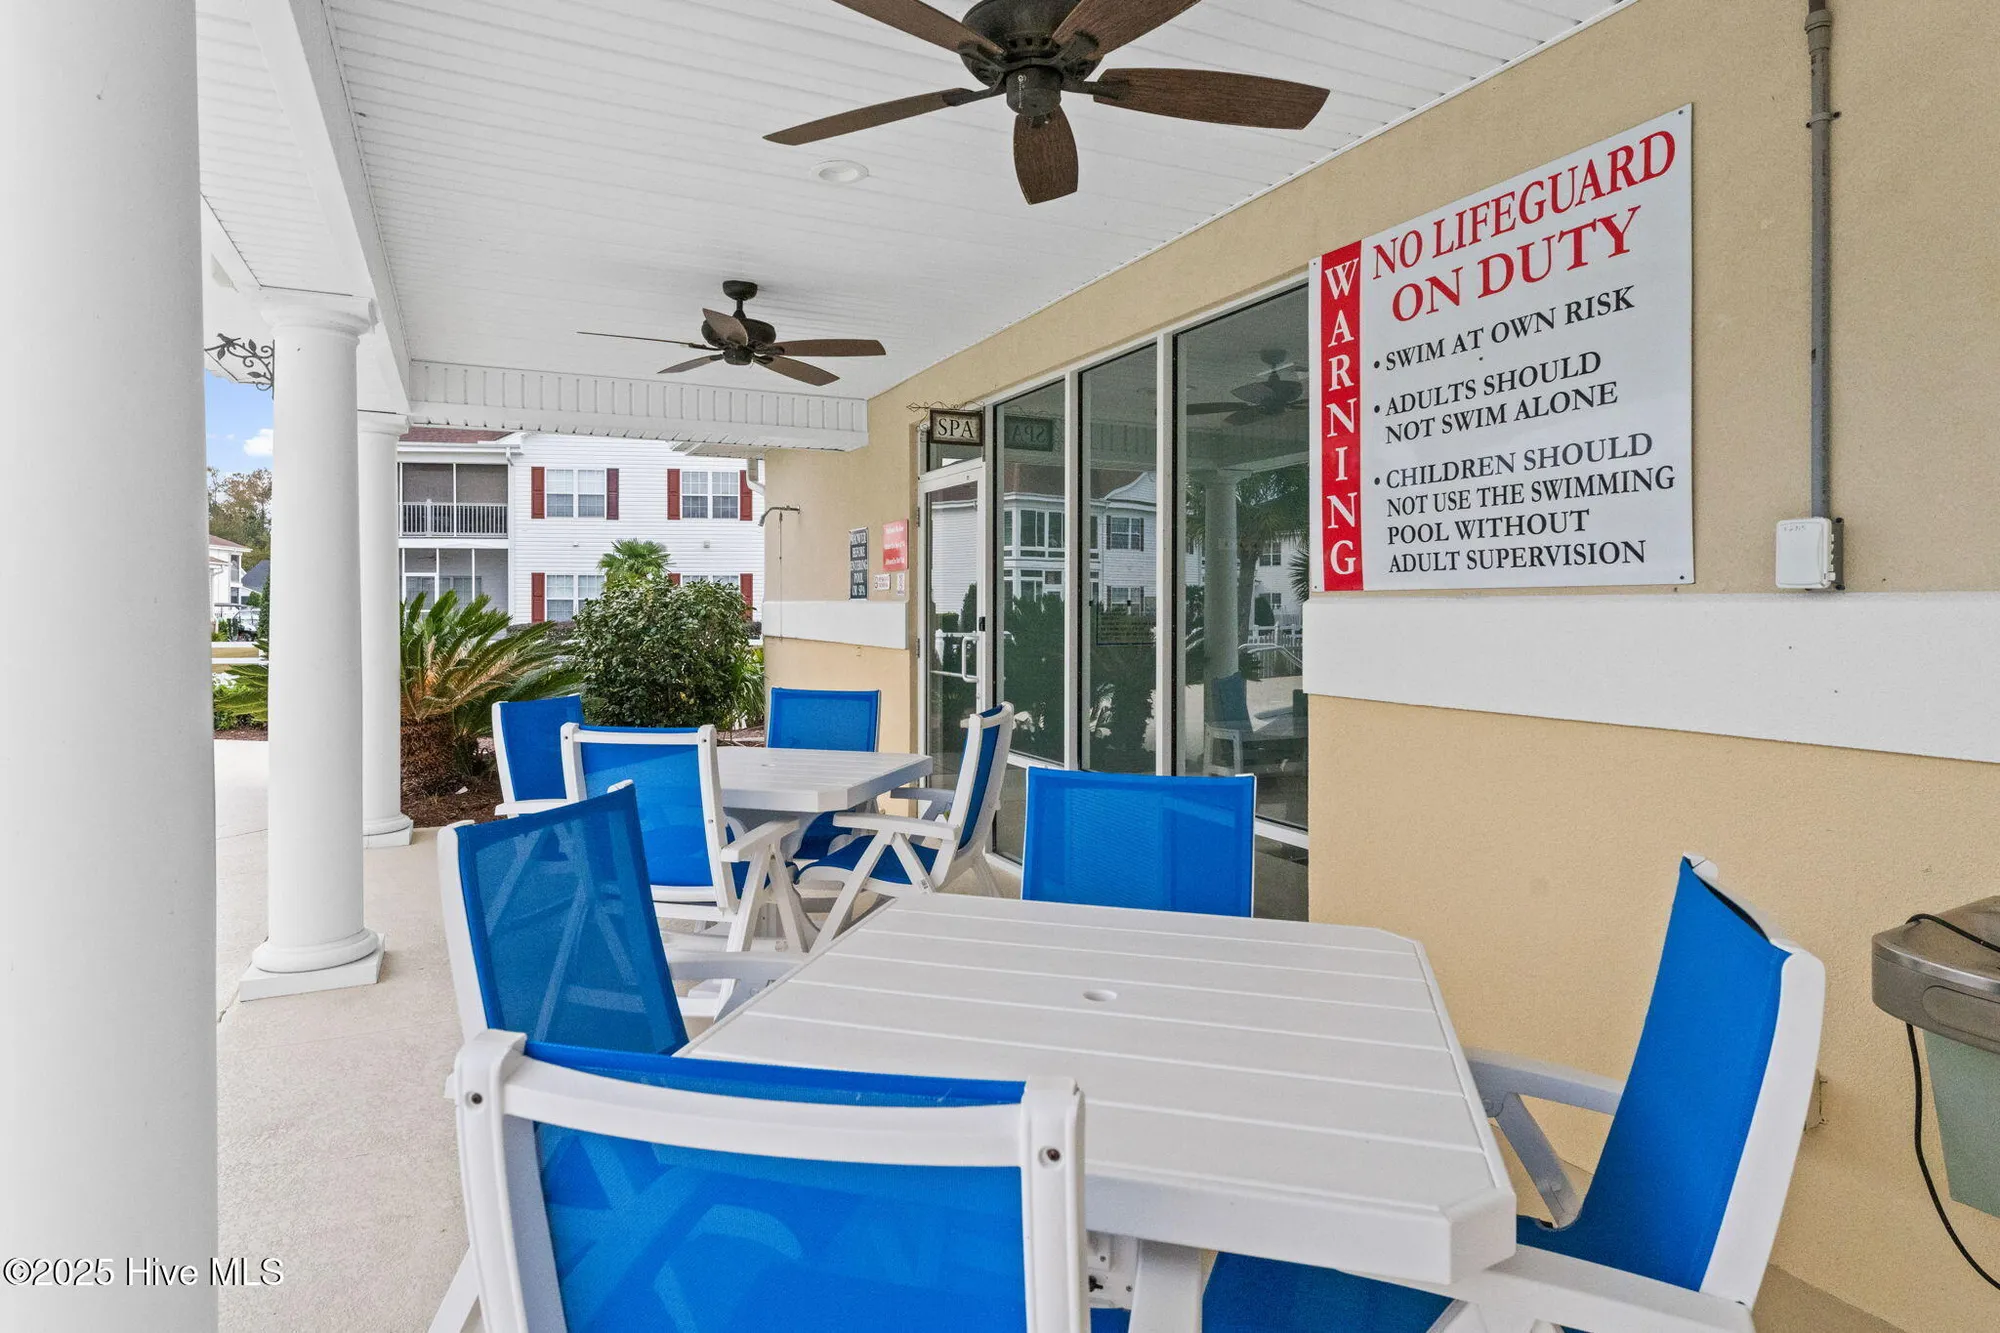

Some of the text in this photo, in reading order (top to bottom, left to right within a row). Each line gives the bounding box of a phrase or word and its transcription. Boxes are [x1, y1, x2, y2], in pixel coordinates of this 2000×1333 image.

[1372, 130, 1676, 280] NO LIFEGUARD
[1391, 205, 1642, 322] ON DUTY
[1386, 285, 1636, 371] SWIM AT OWN RISK
[1384, 381, 1619, 444] NOT SWIM ALONE
[1385, 350, 1601, 416] ADULTS SHOULD
[937, 417, 975, 439] SPA
[1324, 257, 1360, 575] WARNING
[1386, 432, 1653, 490] CHILDREN SHOULD
[1387, 464, 1675, 517] NOT USE THE SWIMMING
[1387, 508, 1590, 545] POOL WITHOUT
[1388, 539, 1647, 573] ADULT SUPERVISION
